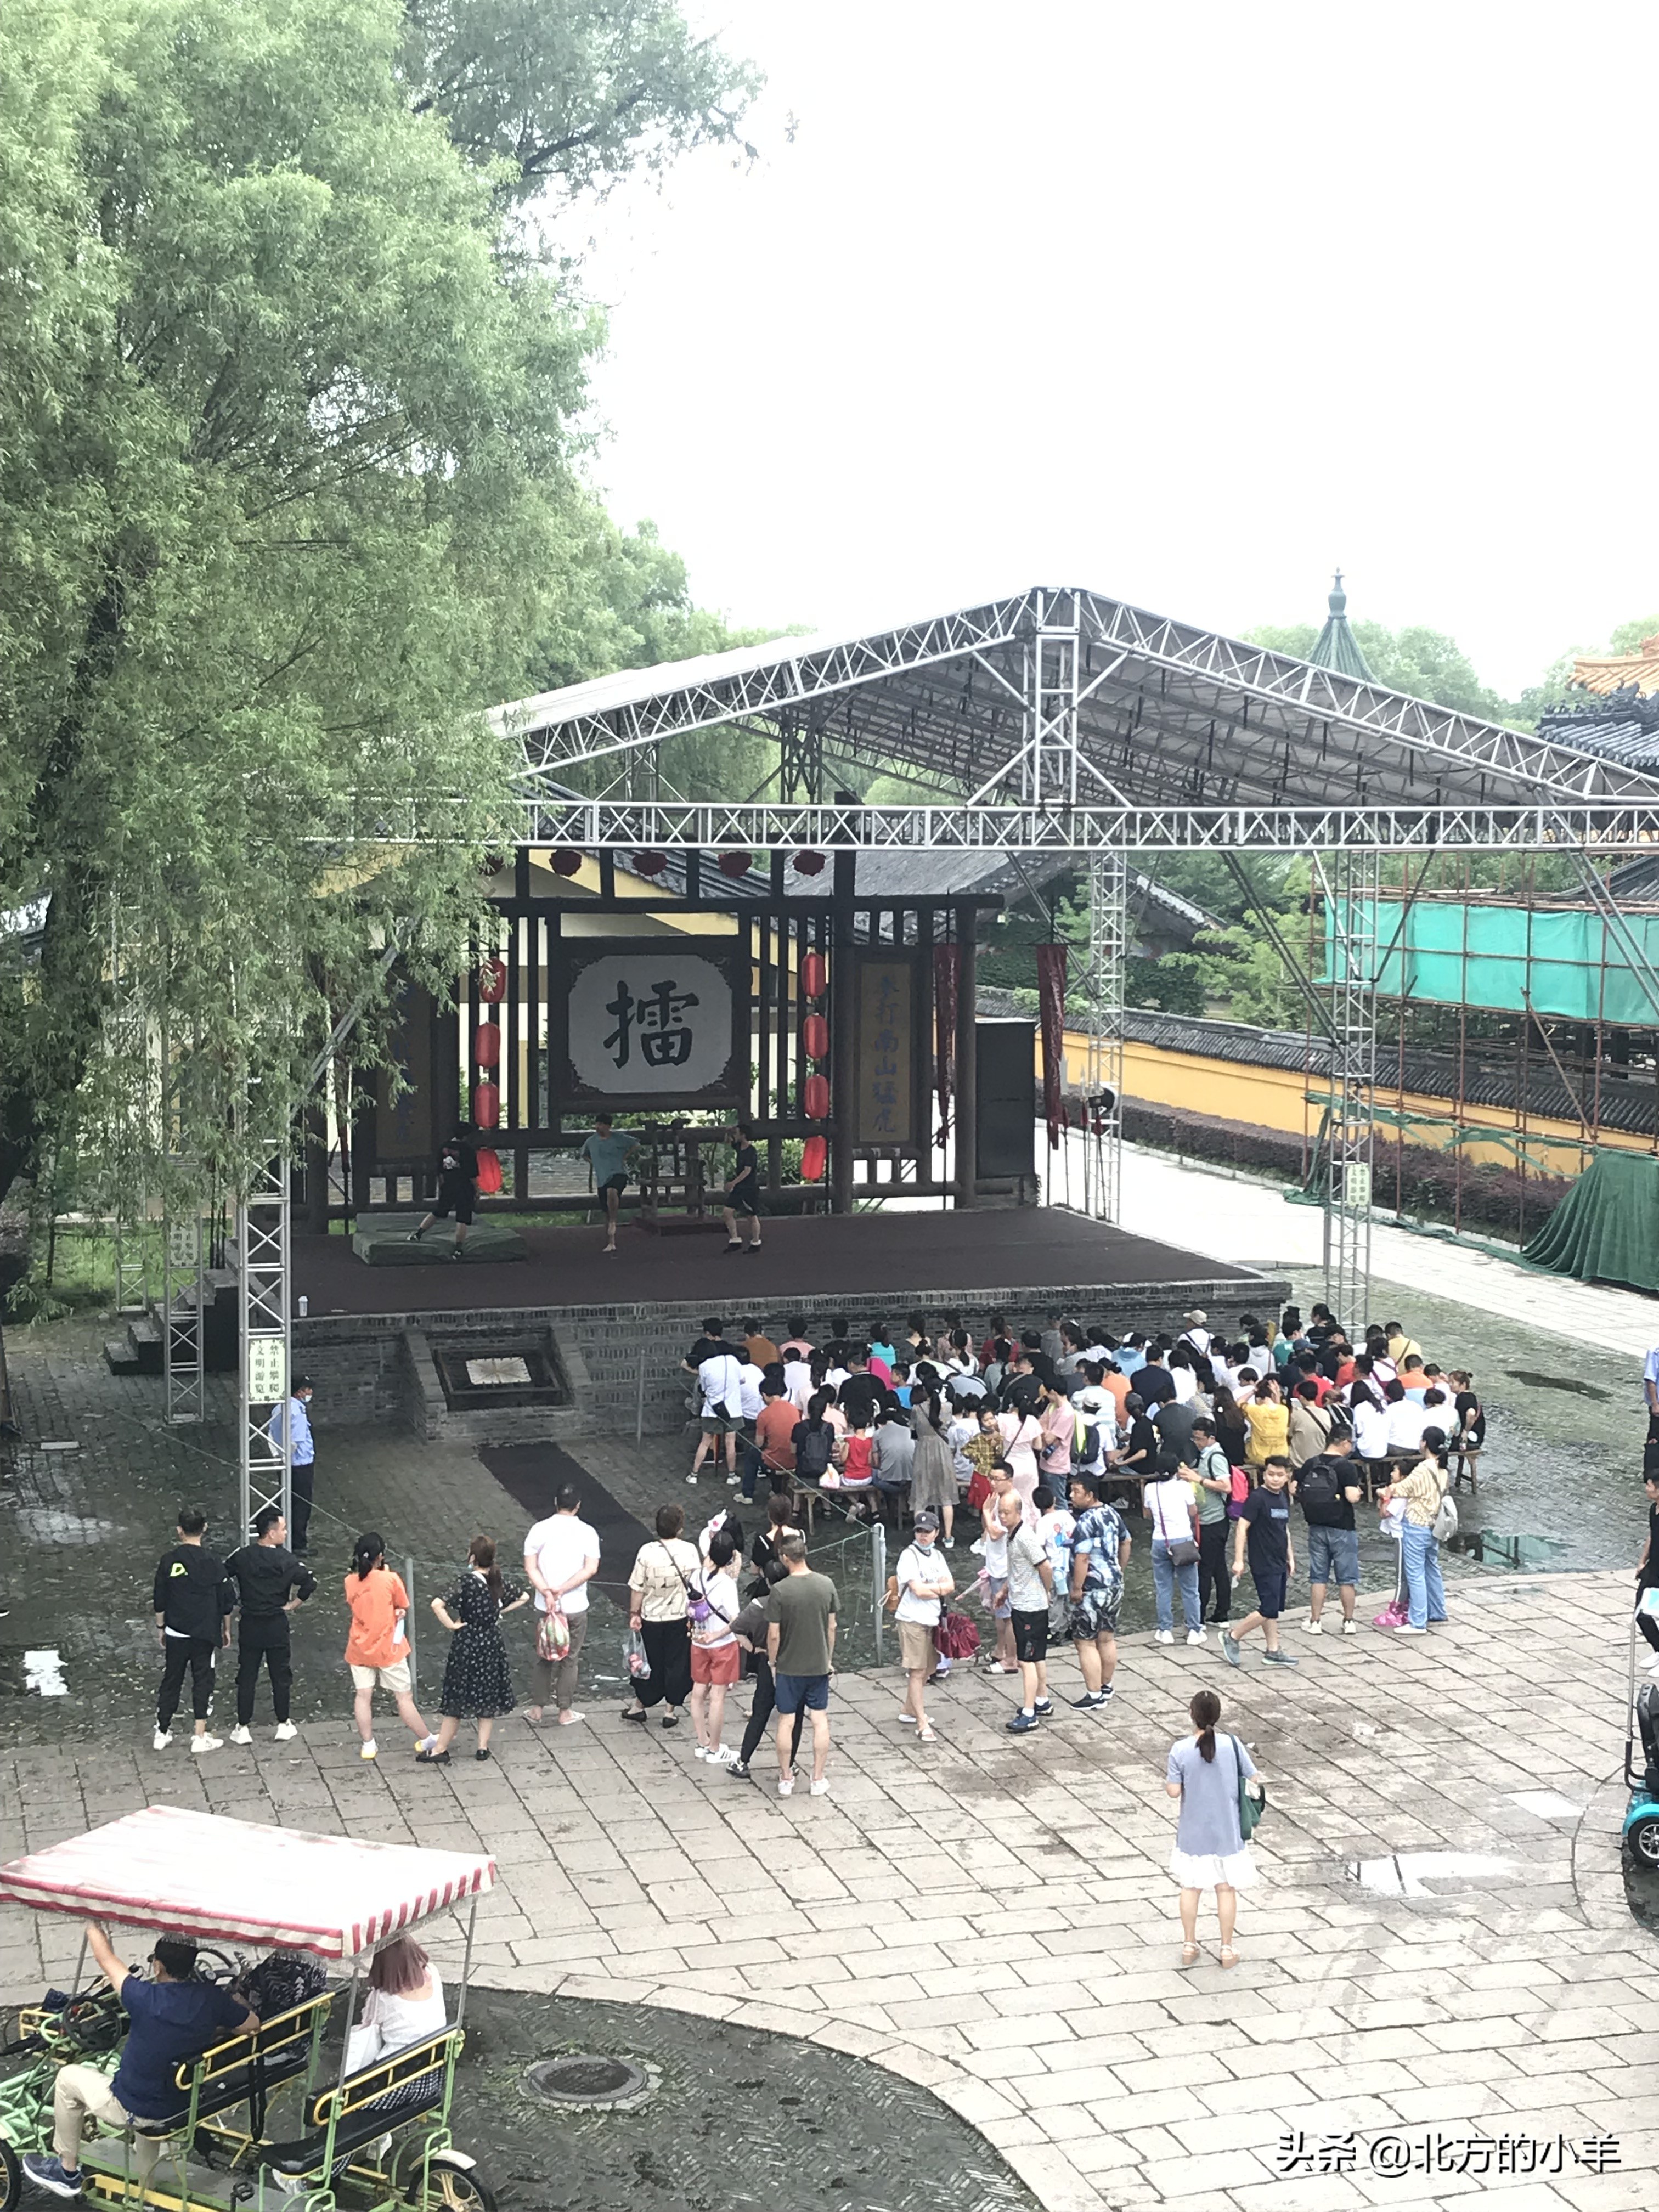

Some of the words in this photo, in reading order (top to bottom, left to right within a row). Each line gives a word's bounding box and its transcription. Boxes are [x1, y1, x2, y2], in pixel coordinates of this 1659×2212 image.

[603, 980, 700, 1070] 擂
[255, 1345, 265, 1394] 文明游览
[269, 1345, 279, 1393] 禁止攀爬
